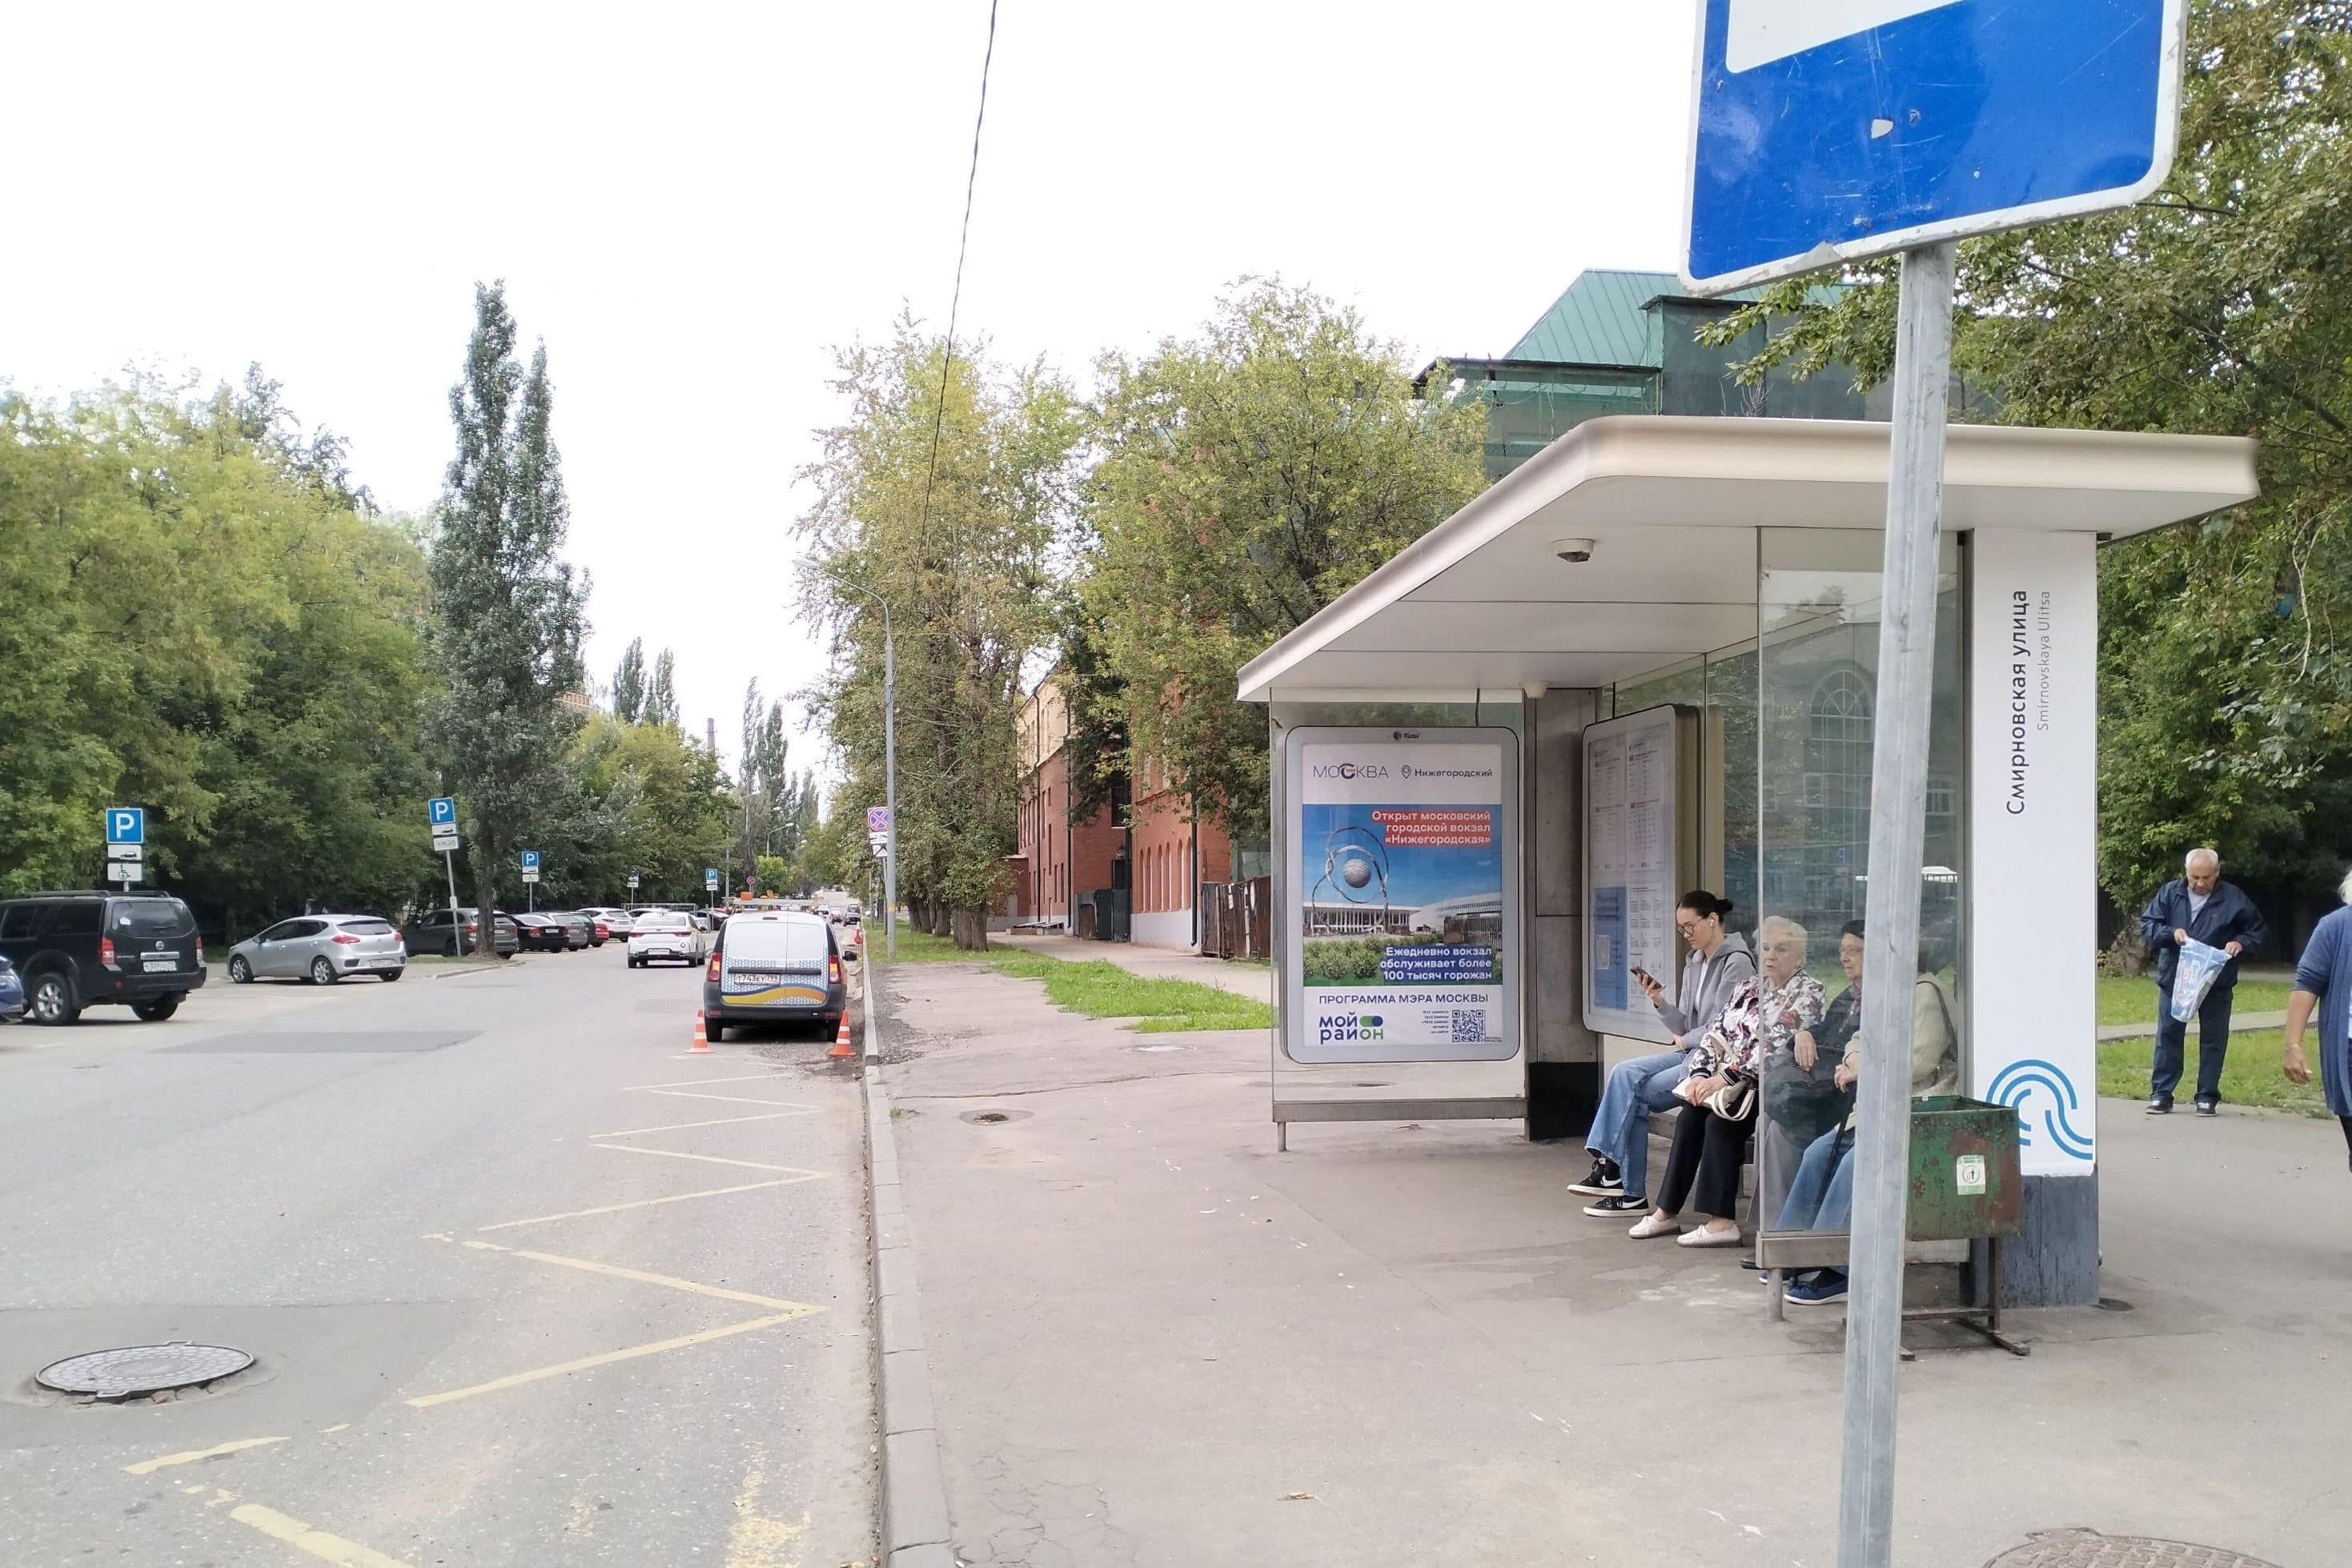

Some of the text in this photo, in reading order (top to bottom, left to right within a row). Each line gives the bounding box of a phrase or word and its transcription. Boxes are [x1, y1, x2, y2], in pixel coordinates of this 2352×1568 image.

[2037, 592, 2052, 731] Smirnovskaya Ulitsa
[2005, 591, 2031, 815] Смирновская улица
[1313, 763, 1389, 780] МОСКВА
[1415, 768, 1493, 778] Нижегородский
[435, 802, 448, 821] P
[1371, 810, 1491, 822] Открыт московский
[115, 812, 134, 839] P
[1386, 823, 1491, 834] городской вокзал
[1385, 834, 1491, 846] «Нижегородская»
[526, 853, 535, 865] P
[708, 870, 715, 878] P
[1386, 947, 1492, 957] Ежедневно вокзал
[1380, 958, 1492, 970] обслуживает более
[1383, 971, 1492, 981] 100 тысяч горожан
[1318, 993, 1488, 1005] ПРОГРАММА МЭРА МОСКВЫ
[1318, 1011, 1358, 1028] мой
